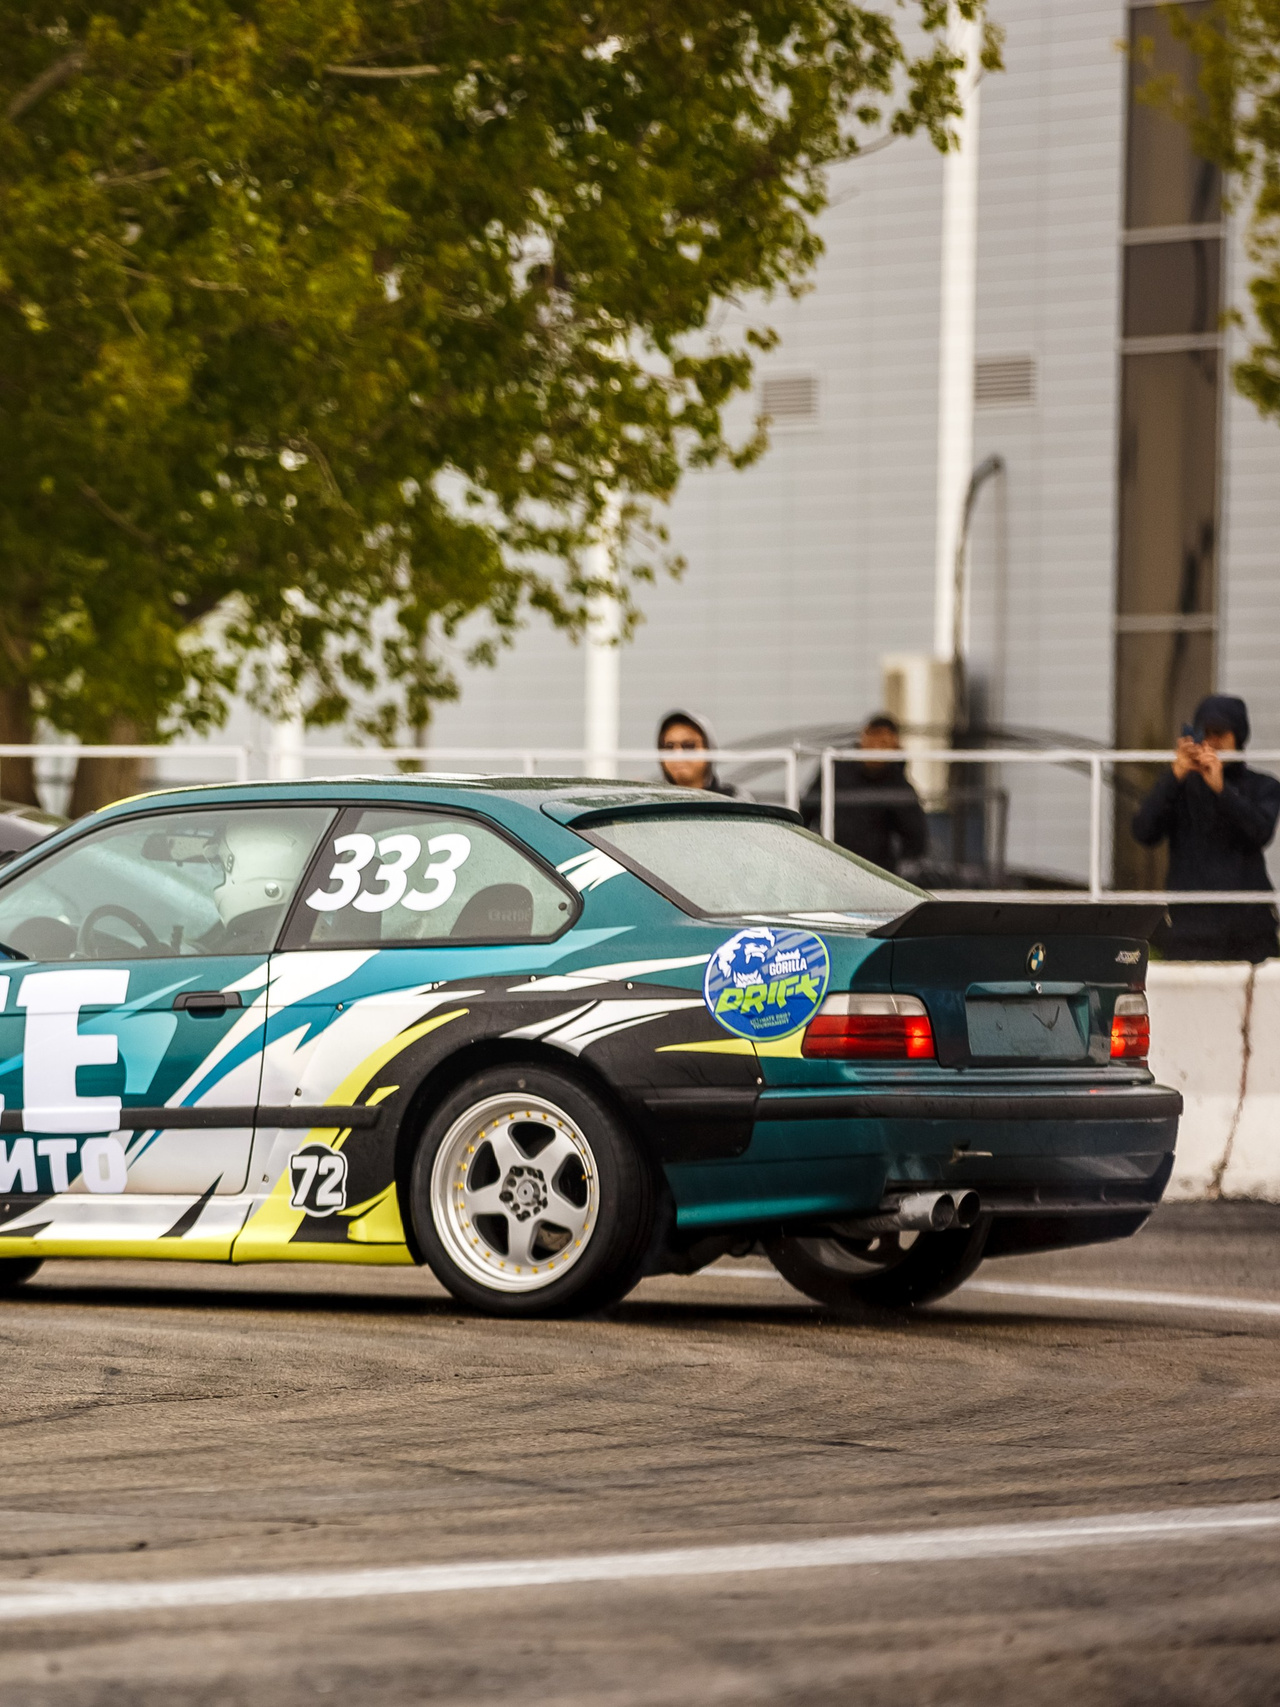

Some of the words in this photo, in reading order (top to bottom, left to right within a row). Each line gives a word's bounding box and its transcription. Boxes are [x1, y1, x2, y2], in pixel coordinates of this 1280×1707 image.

[305, 833, 471, 913] 333
[769, 957, 807, 976] GORILLA
[715, 973, 820, 1015] DRIFT
[292, 1155, 344, 1206] 72
